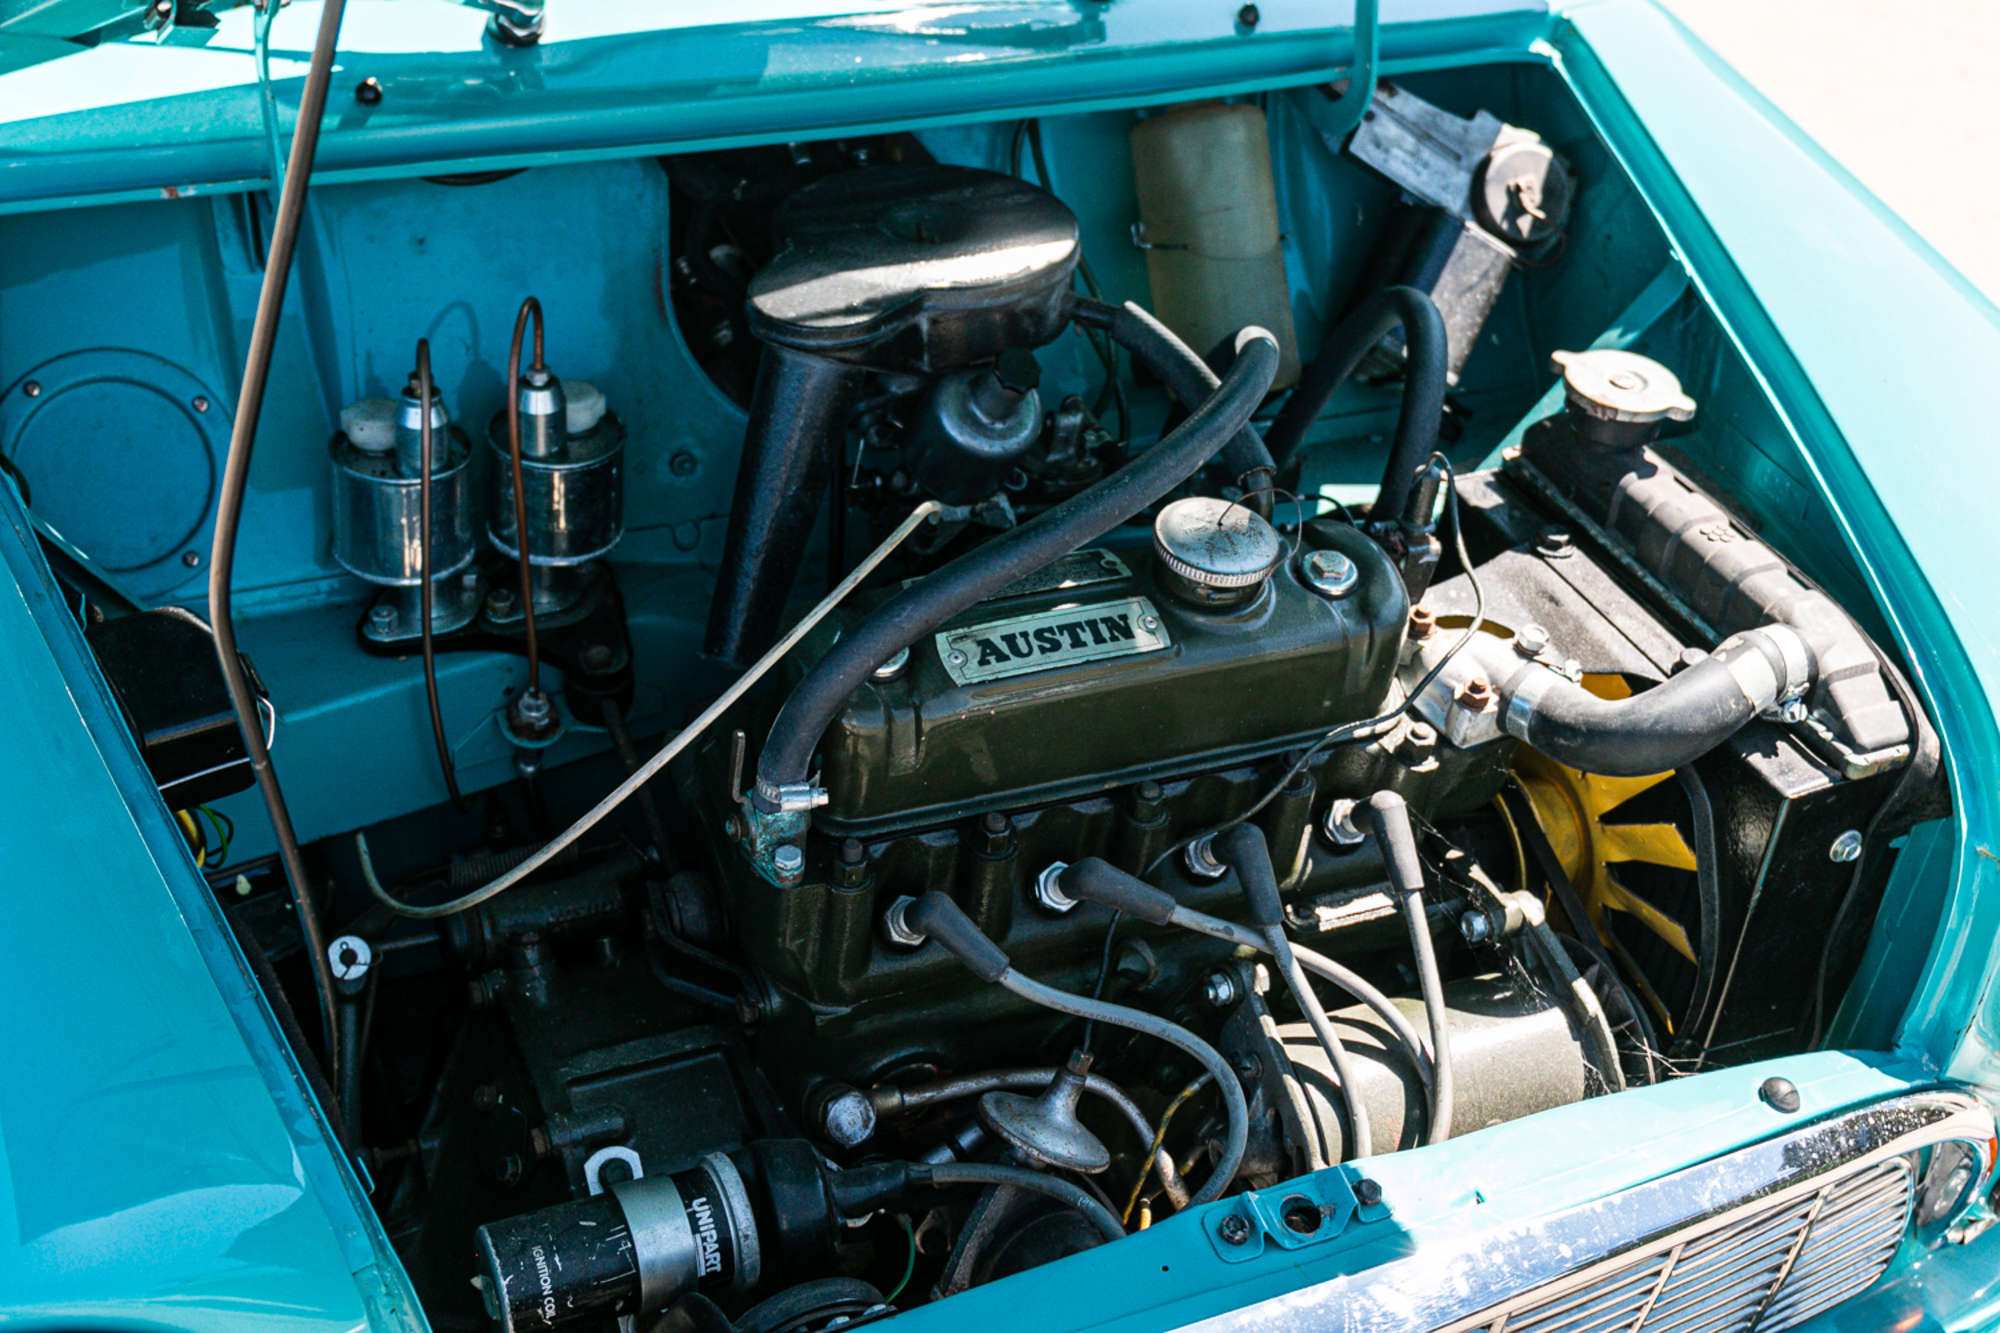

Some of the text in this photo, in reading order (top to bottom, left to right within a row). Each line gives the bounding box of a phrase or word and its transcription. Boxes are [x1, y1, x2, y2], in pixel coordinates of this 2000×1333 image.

[977, 614, 1135, 667] AUSTIN
[692, 1197, 722, 1273] UNIPART
[532, 1245, 553, 1295] IGNITION
